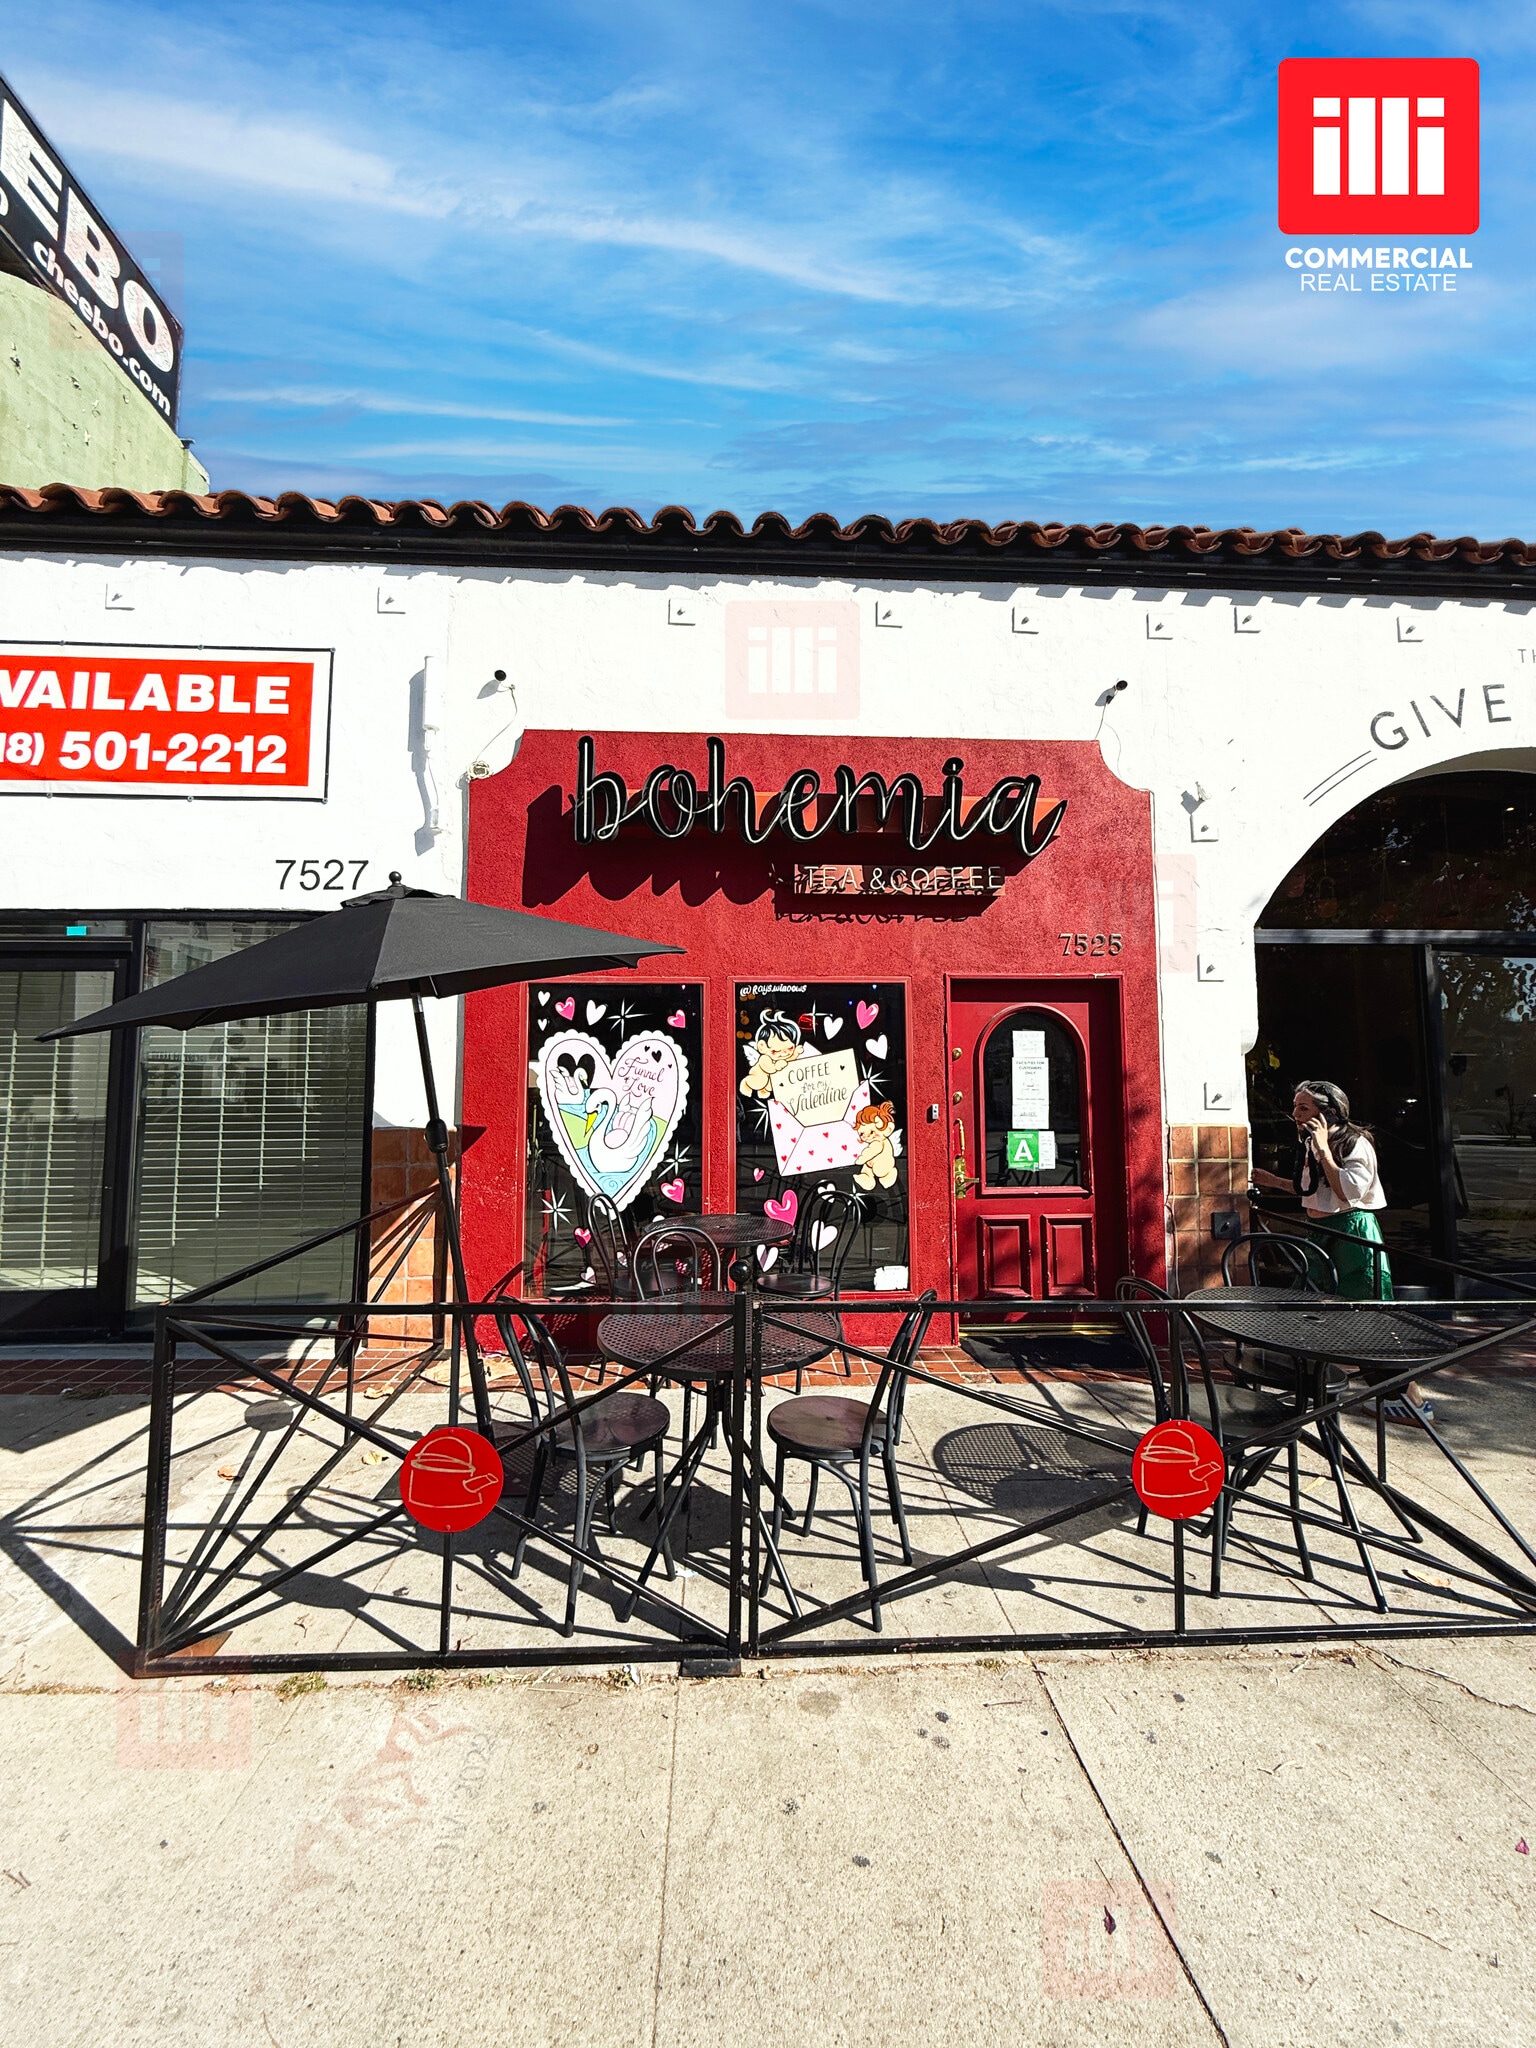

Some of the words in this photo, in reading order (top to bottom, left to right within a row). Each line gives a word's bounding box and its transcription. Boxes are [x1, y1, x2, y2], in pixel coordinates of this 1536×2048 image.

[33, 240, 172, 416] cheebo.com
[0, 669, 290, 714] VAILABLE
[1370, 683, 1512, 750] GIVE
[58, 731, 287, 774] 501-2212
[572, 735, 1067, 857] bohemia
[275, 859, 369, 890] 7527
[804, 866, 859, 890] TEA
[1058, 933, 1123, 956] 7525
[617, 1056, 665, 1083] Funnel
[788, 1061, 830, 1085] COFFEE
[622, 1077, 656, 1098] Love
[787, 1086, 848, 1117] Valentine
[1013, 1138, 1034, 1161] A
